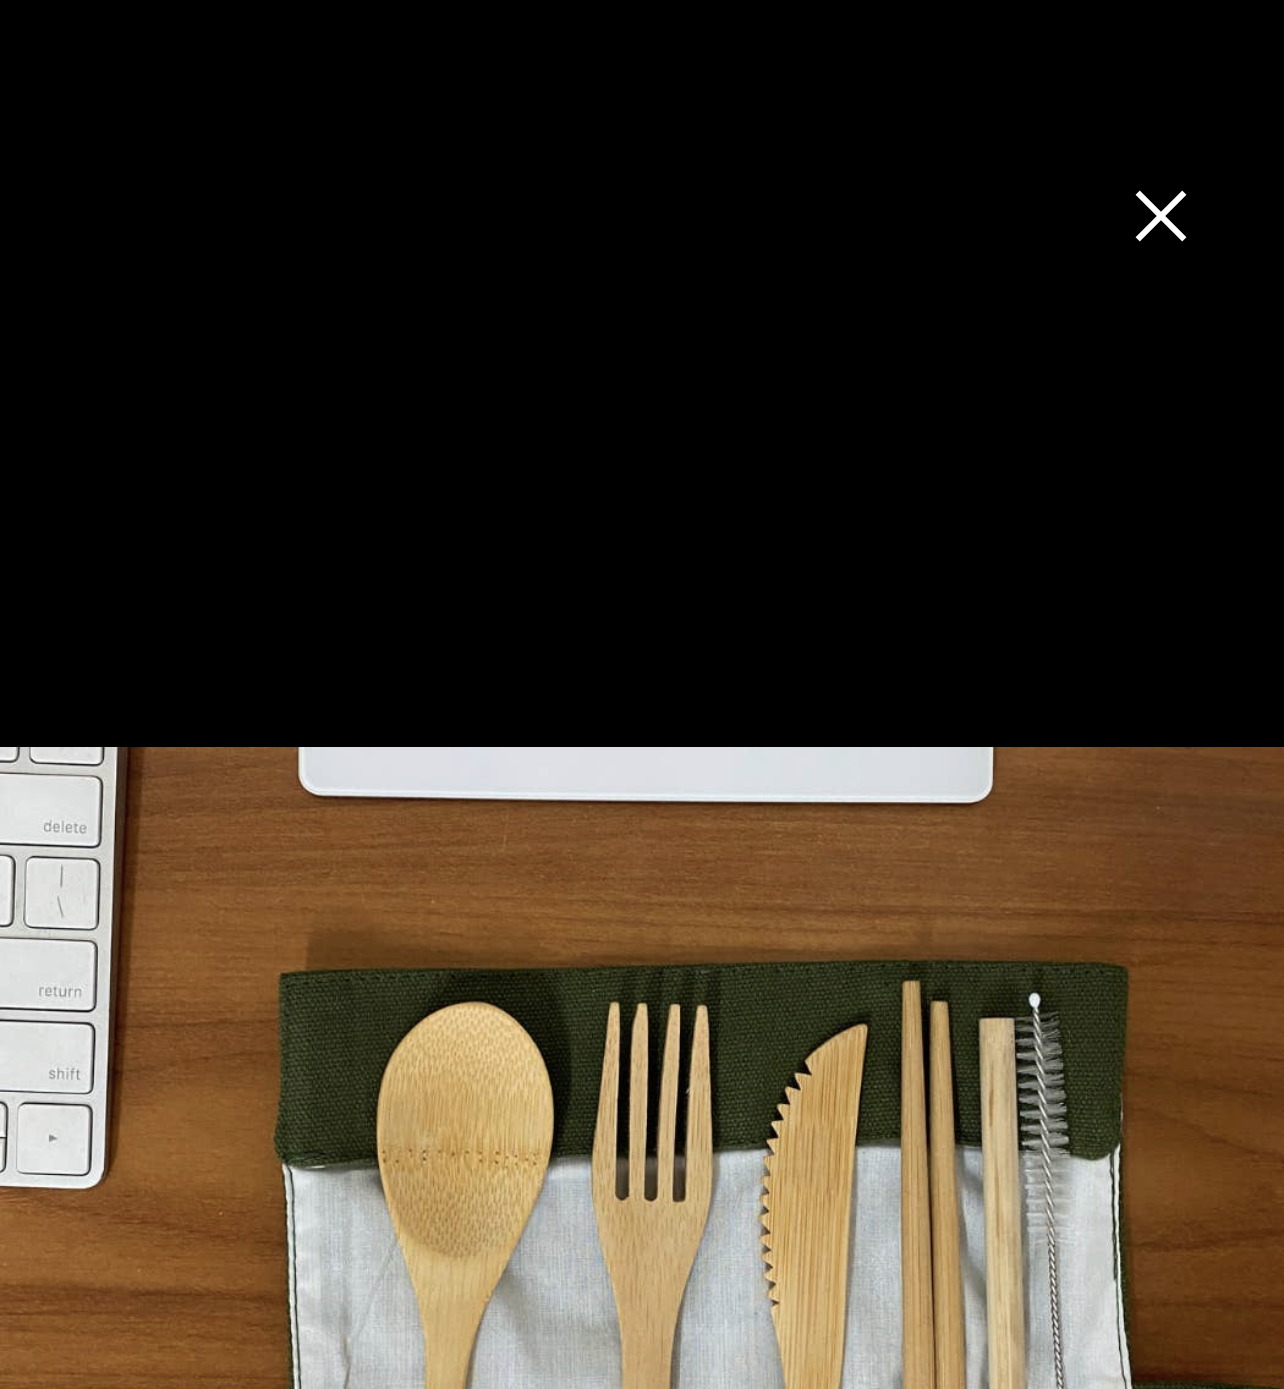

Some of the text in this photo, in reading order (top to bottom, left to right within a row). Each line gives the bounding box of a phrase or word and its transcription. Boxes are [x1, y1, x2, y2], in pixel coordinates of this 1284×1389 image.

[43, 819, 88, 835] delete
[38, 983, 82, 998] return
[48, 1066, 81, 1080] shift
